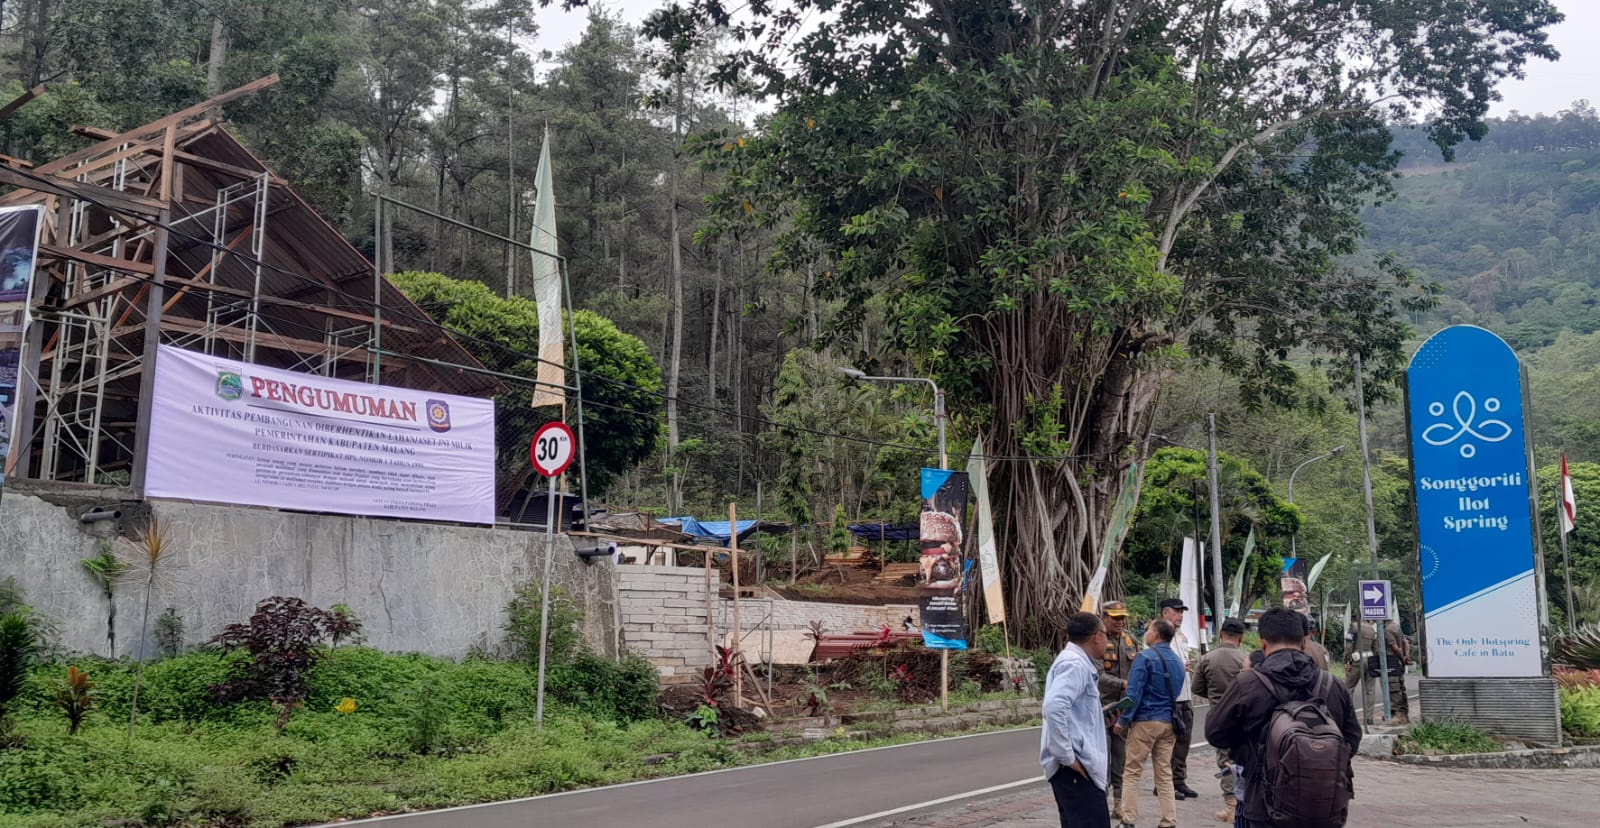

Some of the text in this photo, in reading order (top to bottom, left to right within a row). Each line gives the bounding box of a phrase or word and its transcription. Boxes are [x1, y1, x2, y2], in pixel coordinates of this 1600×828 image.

[249, 376, 416, 421] PENGUMUMAN
[192, 404, 242, 420] AKTIVITAS
[244, 412, 313, 430] PEMBANGUNAN
[316, 422, 386, 440] DIBERHENTIKAN
[255, 428, 416, 456] PEMERINTAHAN KABUPATEN MALANG
[538, 436, 558, 460] 30
[1420, 472, 1521, 492] Songgoriti
[1459, 497, 1490, 511] Hot
[1444, 514, 1508, 532] Spring
[1364, 608, 1384, 616] MASUK
[1436, 636, 1530, 647] The Only Hotspring
[1454, 648, 1514, 656] Cafe in Batu
